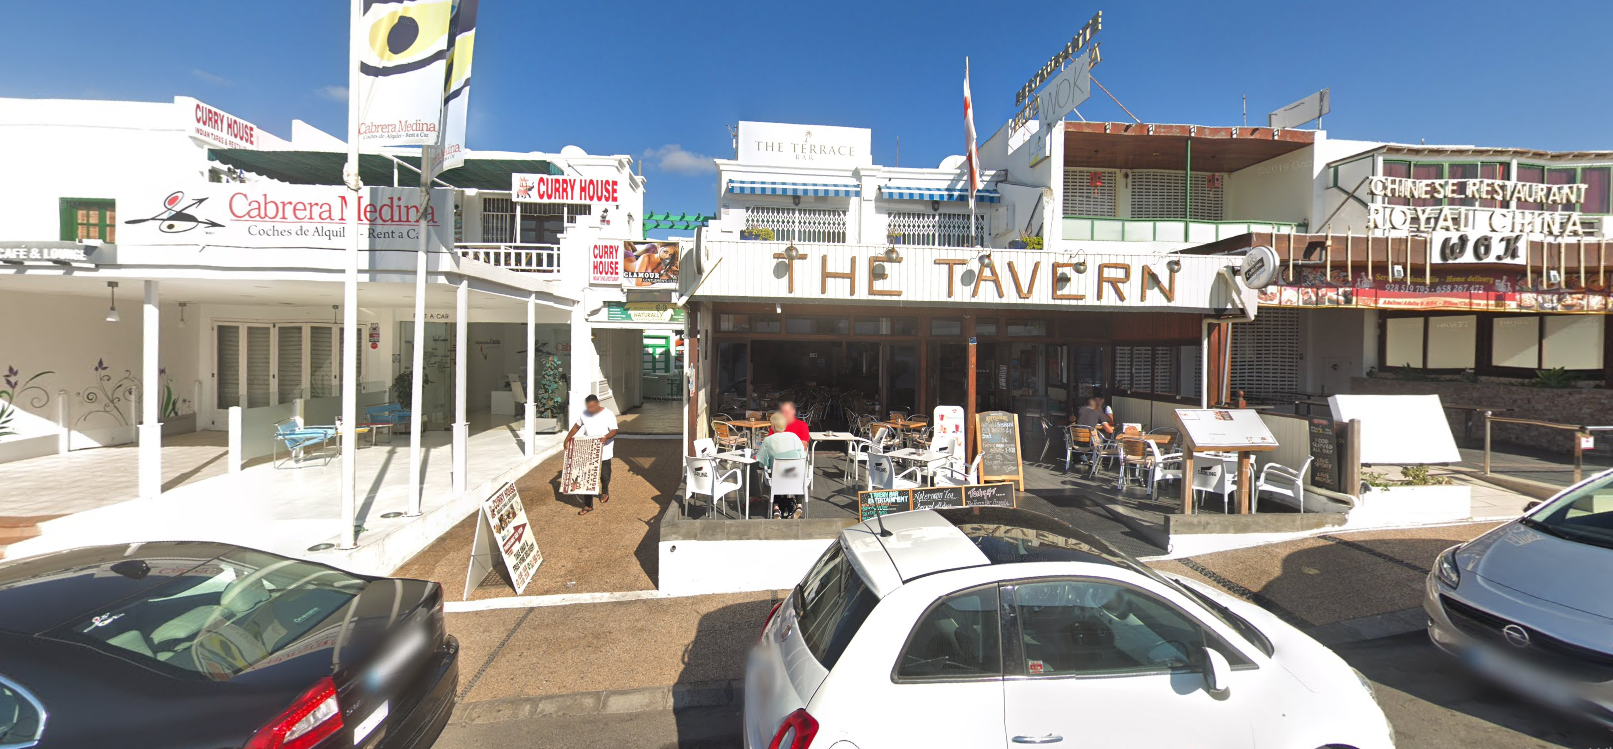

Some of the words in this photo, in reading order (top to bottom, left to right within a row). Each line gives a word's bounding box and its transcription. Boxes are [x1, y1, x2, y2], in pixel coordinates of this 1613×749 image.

[1040, 62, 1084, 121] WOK
[195, 103, 224, 132] CURRY
[227, 116, 254, 145] HOUSE
[358, 122, 396, 135] Cabrera
[398, 119, 437, 132] Medina
[195, 126, 210, 138] INDIAN
[211, 132, 224, 144] TAPAS
[754, 140, 784, 152] THE
[791, 142, 855, 157] TERRACE
[537, 176, 576, 201] CURRY
[579, 179, 618, 202] HOUSE
[1370, 177, 1458, 199] CHINESE
[1466, 179, 1589, 203] RESTAURANT
[229, 192, 335, 221] Cabrera
[1367, 203, 1472, 232] ROYAL
[1489, 209, 1584, 236] CHINA
[247, 225, 293, 237] Coches
[298, 226, 309, 237] de
[312, 226, 346, 240] Alquil
[367, 227, 395, 239] Rent
[398, 231, 404, 239] a
[406, 228, 420, 239] Ca
[29, 248, 41, 259] &
[593, 244, 619, 259] CURRY
[1440, 233, 1522, 262] WOK
[593, 261, 619, 275] HOUSE
[623, 271, 660, 279] GLAMOUR
[773, 253, 903, 296] THE
[934, 258, 1175, 301] TAVERN
[1385, 284, 1400, 292] 928
[1400, 284, 1414, 293] 519
[1415, 285, 1430, 293] 795
[1436, 285, 1452, 293] 658
[1453, 284, 1468, 292] 267
[1469, 285, 1484, 293] 473
[633, 311, 664, 319] NATURALLY
[591, 465, 599, 491] HOUSE
